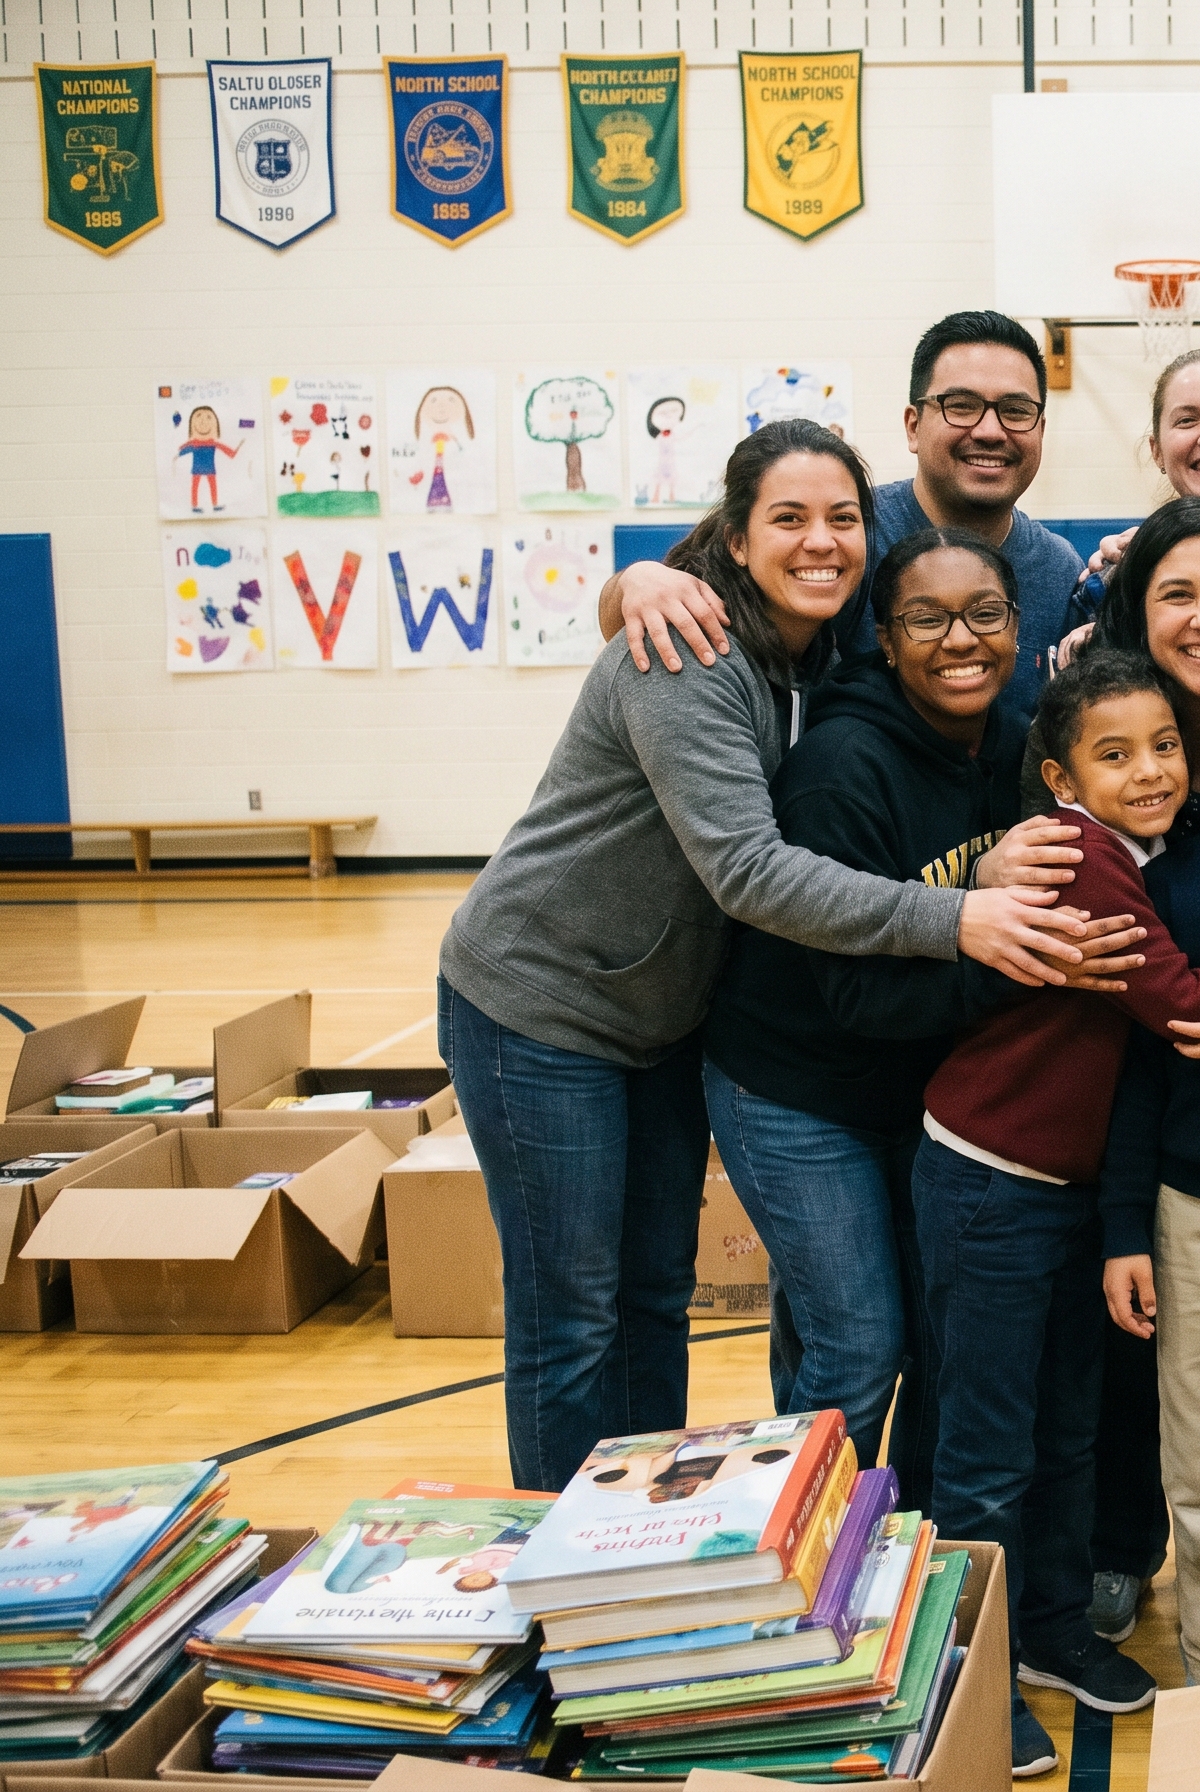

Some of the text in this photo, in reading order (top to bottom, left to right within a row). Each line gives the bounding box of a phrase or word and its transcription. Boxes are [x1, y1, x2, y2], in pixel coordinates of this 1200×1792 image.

[748, 64, 857, 82] NORTH SCHOOL
[62, 79, 132, 95] NATIONAL
[218, 76, 264, 92] SALTU
[448, 74, 500, 93] SCHOOL
[579, 87, 667, 105] CHAMPIONS
[761, 85, 845, 102] CHAMPIONS
[56, 97, 139, 115] CHAMPIONS
[230, 95, 312, 111] CHAMPIONS
[785, 200, 823, 215] 1989
[85, 211, 122, 228] 1985
[283, 549, 363, 662] V
[387, 547, 494, 653] W
